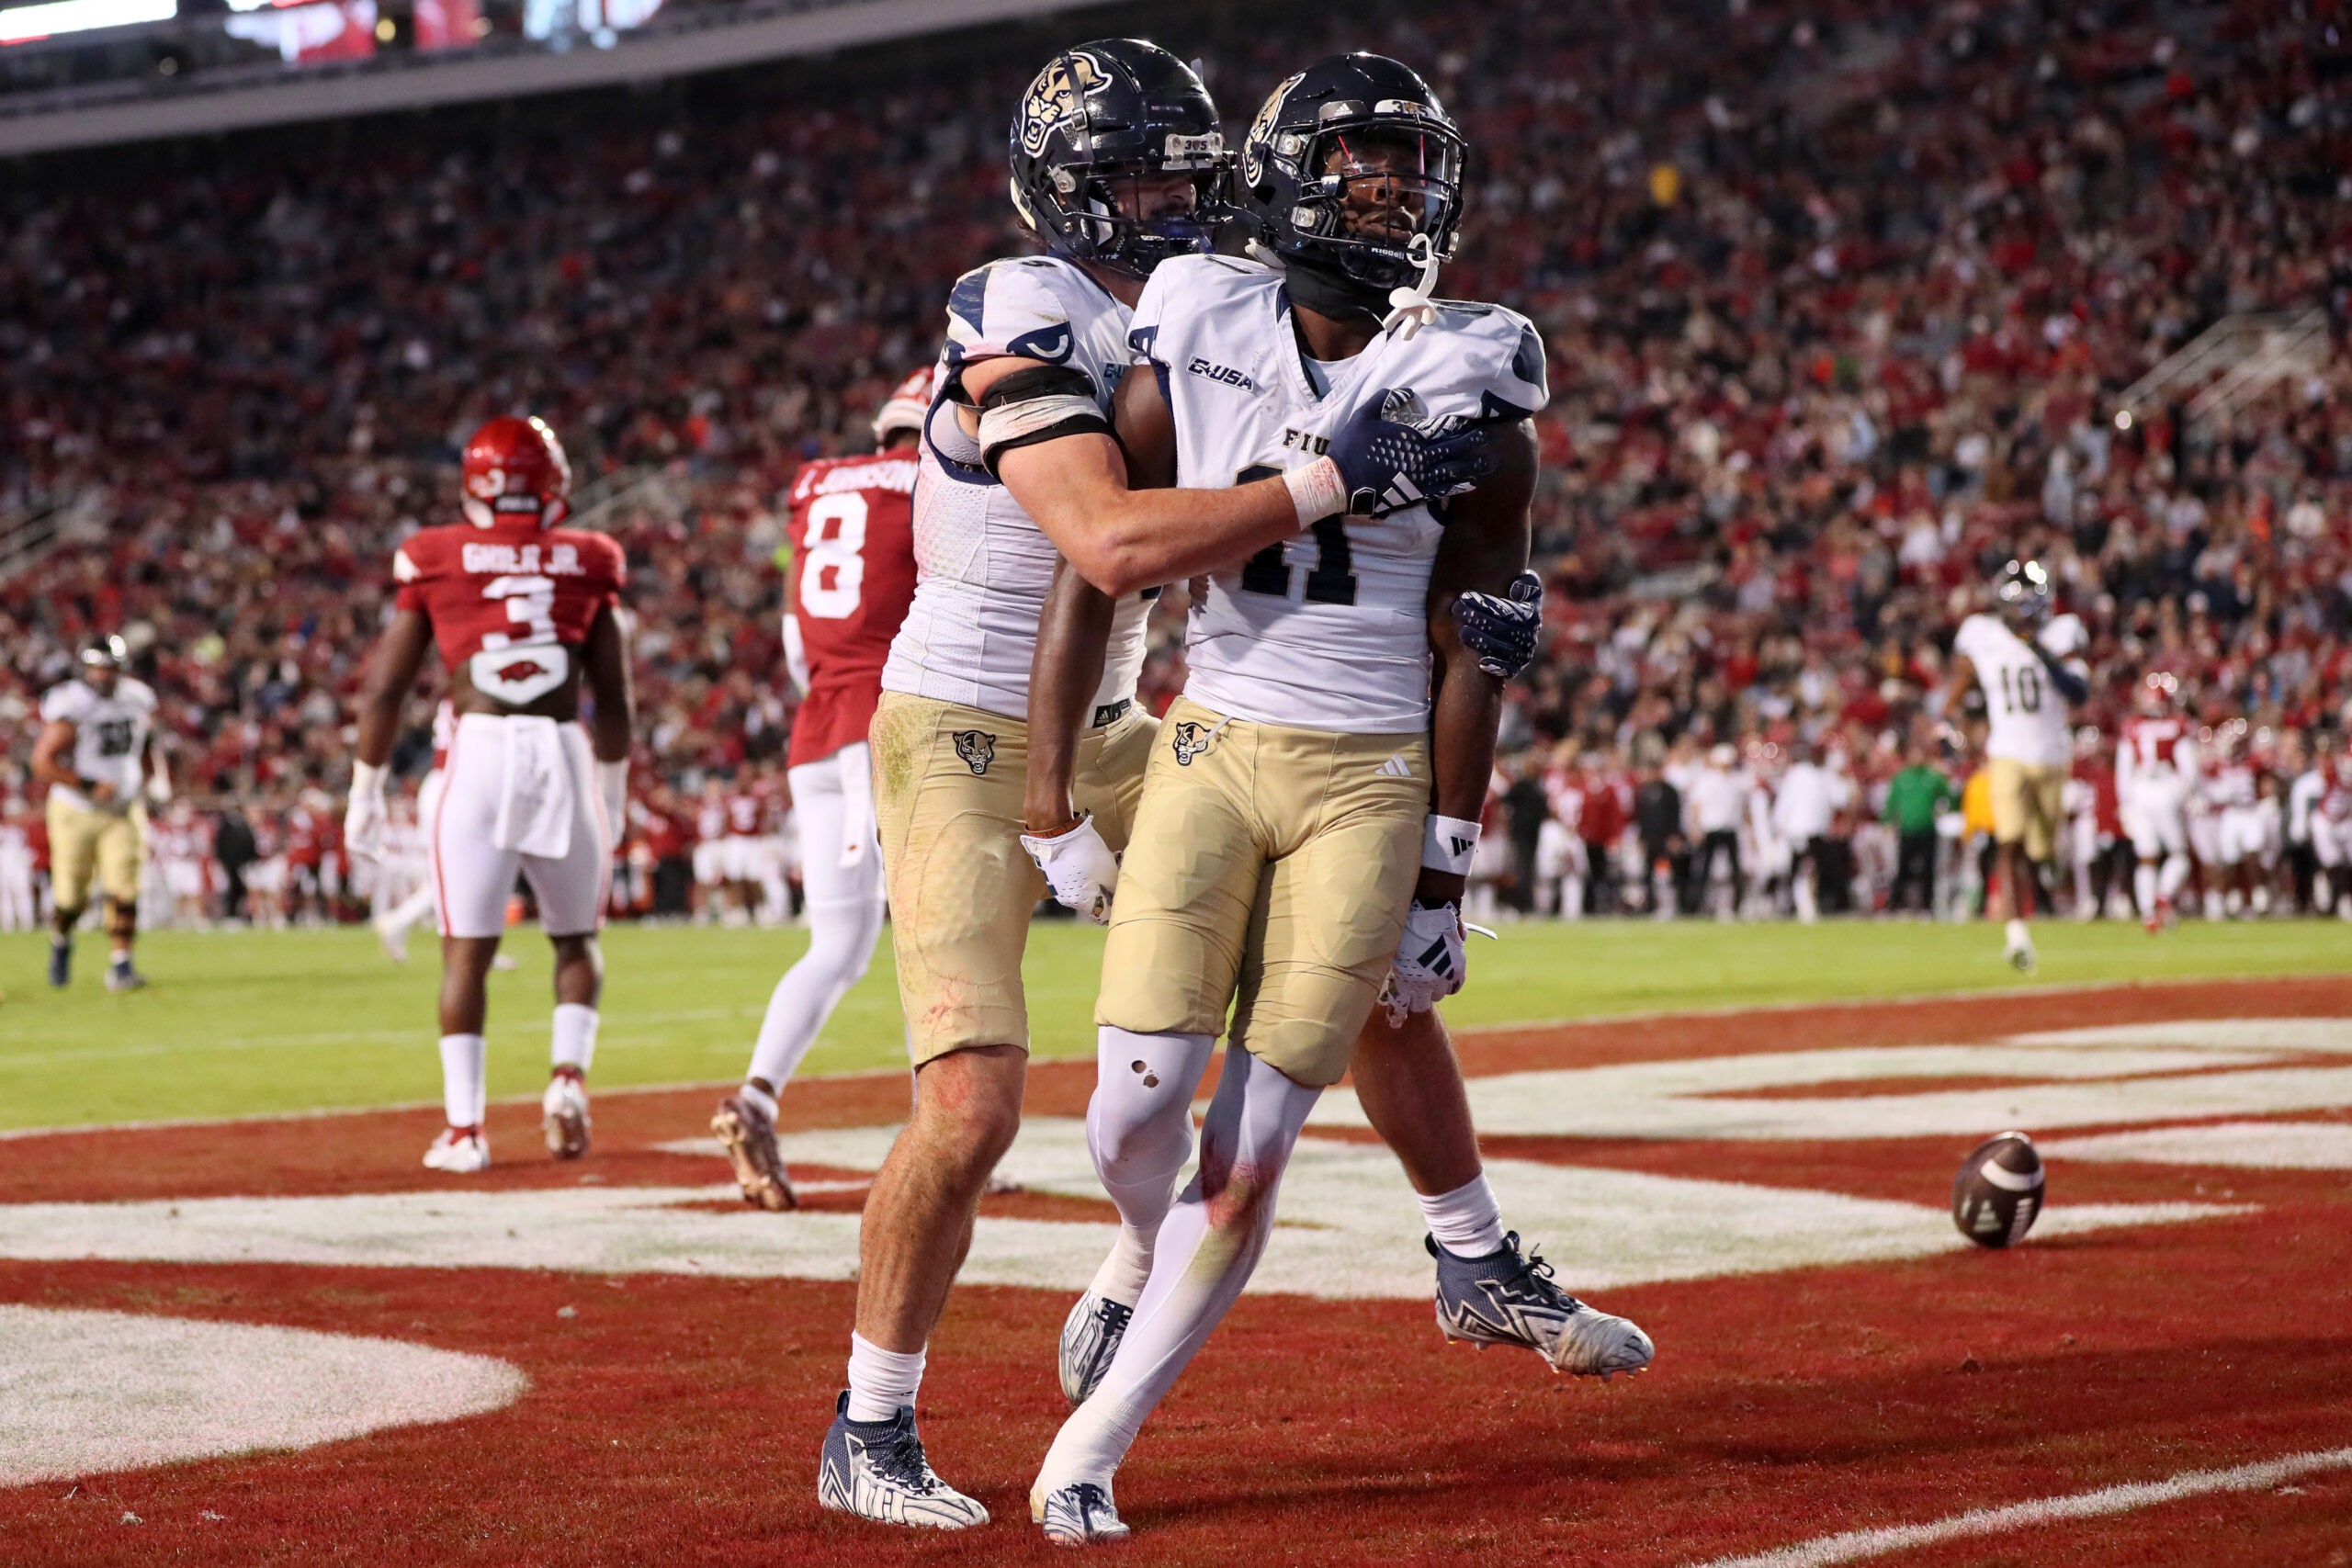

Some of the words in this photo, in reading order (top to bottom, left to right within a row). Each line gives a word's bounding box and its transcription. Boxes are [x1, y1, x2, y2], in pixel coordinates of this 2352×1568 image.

[1282, 426, 1331, 457] FIU
[800, 491, 868, 620] 8
[481, 575, 559, 652] 3
[2000, 665, 2041, 715] 10
